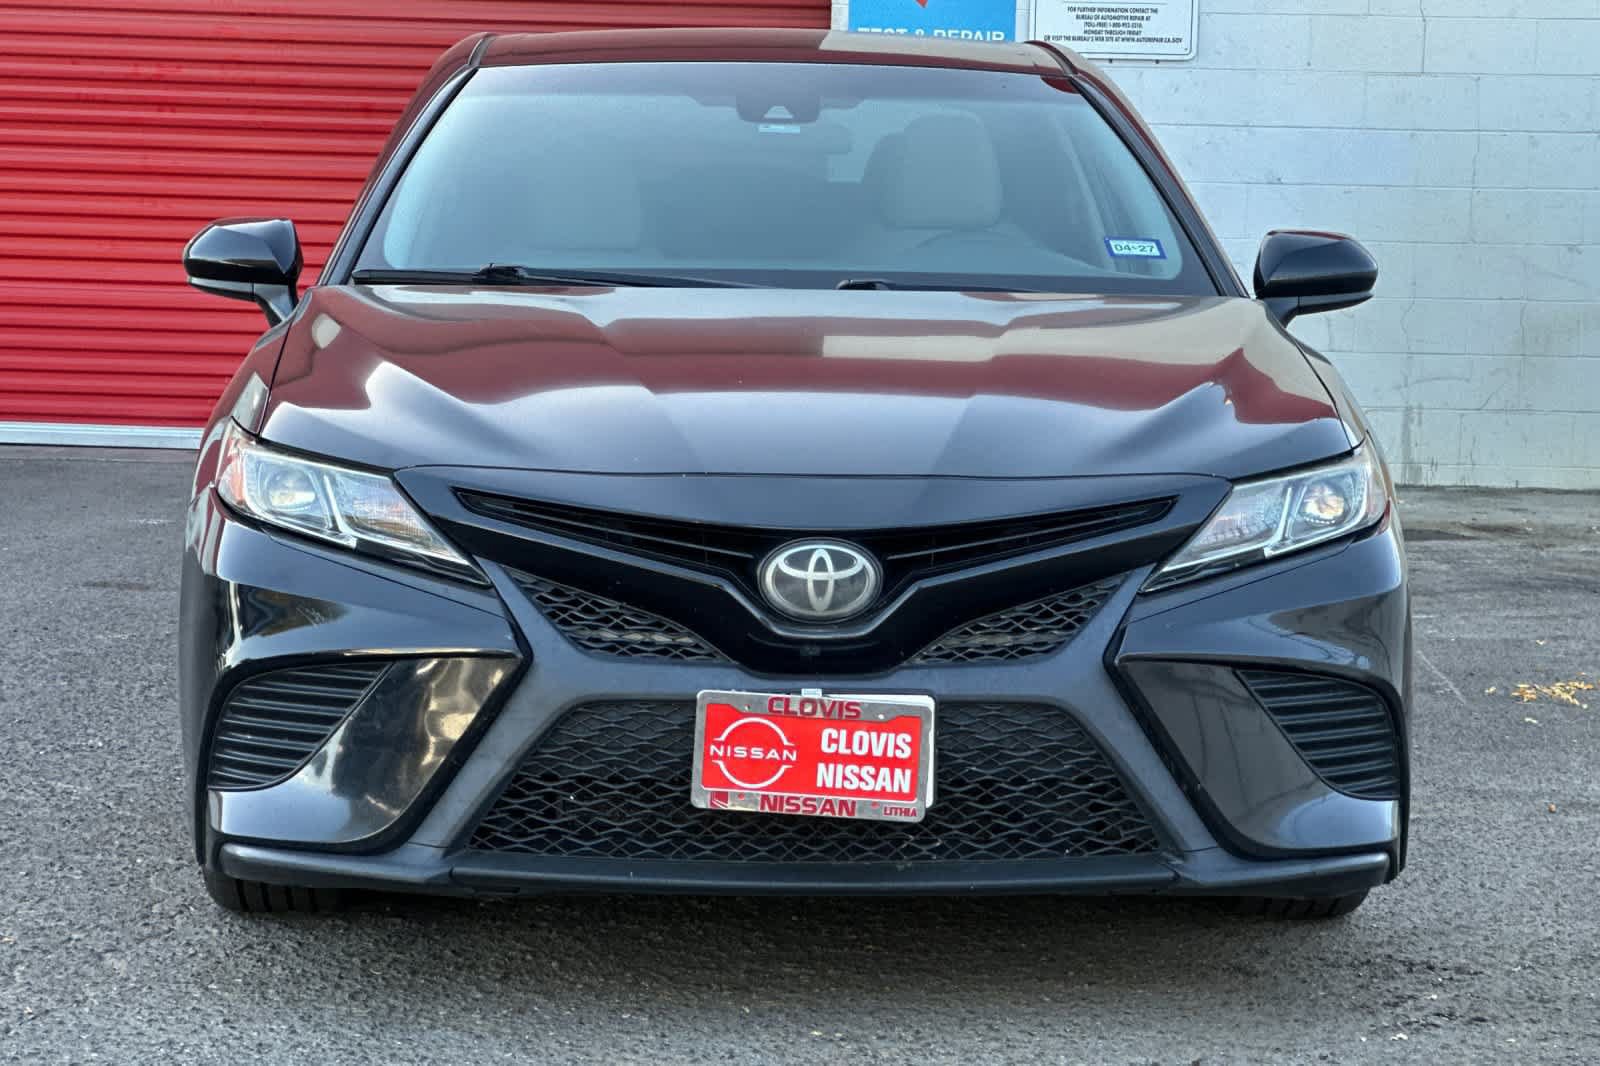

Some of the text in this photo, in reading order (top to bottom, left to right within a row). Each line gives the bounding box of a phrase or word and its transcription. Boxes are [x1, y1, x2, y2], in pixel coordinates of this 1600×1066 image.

[767, 696, 862, 720] CLOVIS
[709, 744, 797, 761] NISSAN
[821, 727, 912, 758] CLOVIS
[816, 763, 912, 793] NISSAN
[759, 794, 917, 818] NISSAN LITHIA
